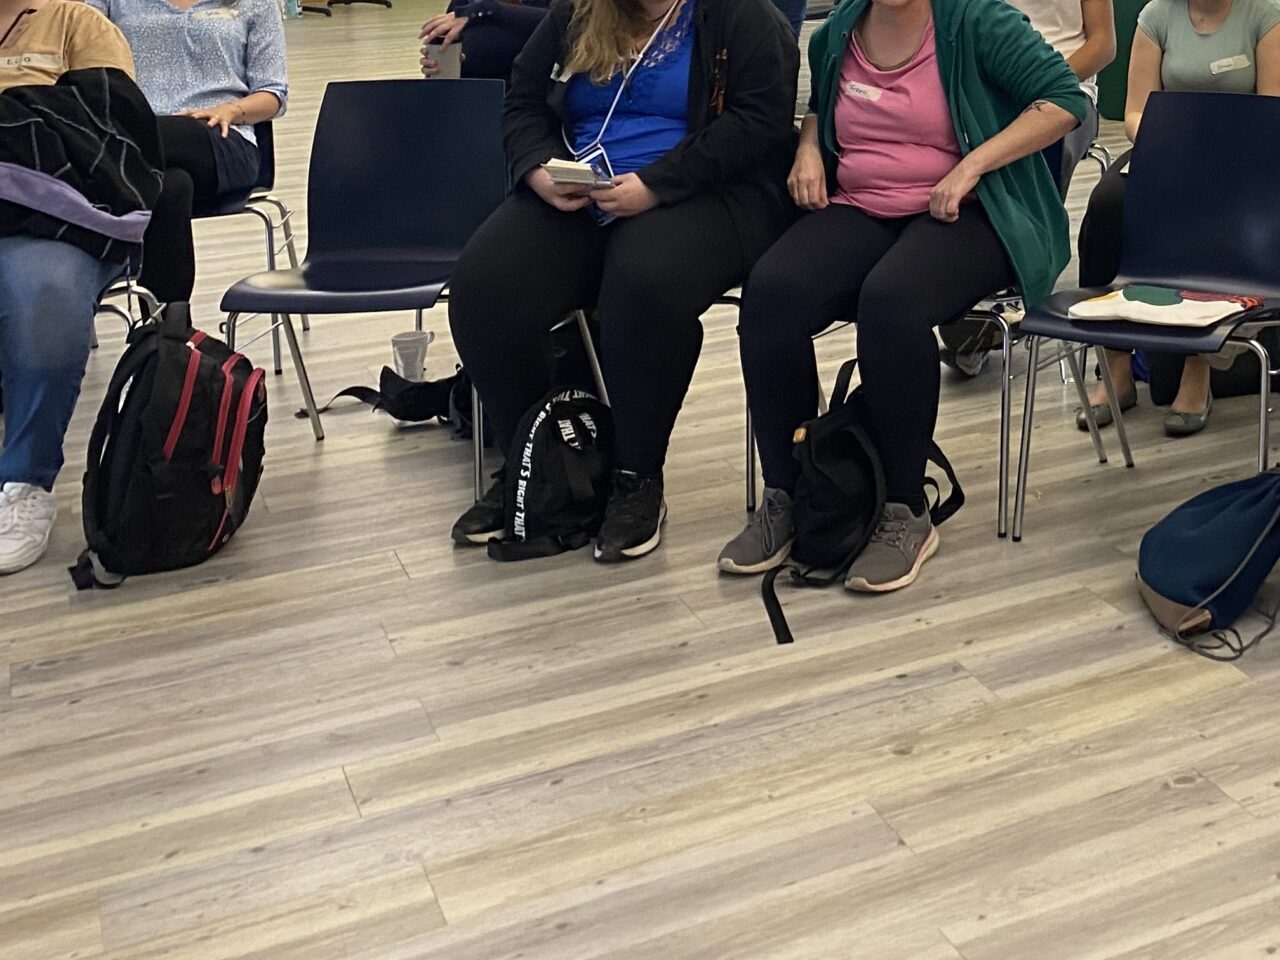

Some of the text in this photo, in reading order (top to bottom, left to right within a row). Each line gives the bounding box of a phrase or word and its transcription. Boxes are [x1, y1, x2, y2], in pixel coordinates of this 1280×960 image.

[528, 410, 547, 441] RIGHT
[520, 442, 533, 479] THAT'S
[516, 479, 527, 510] RIGHT
